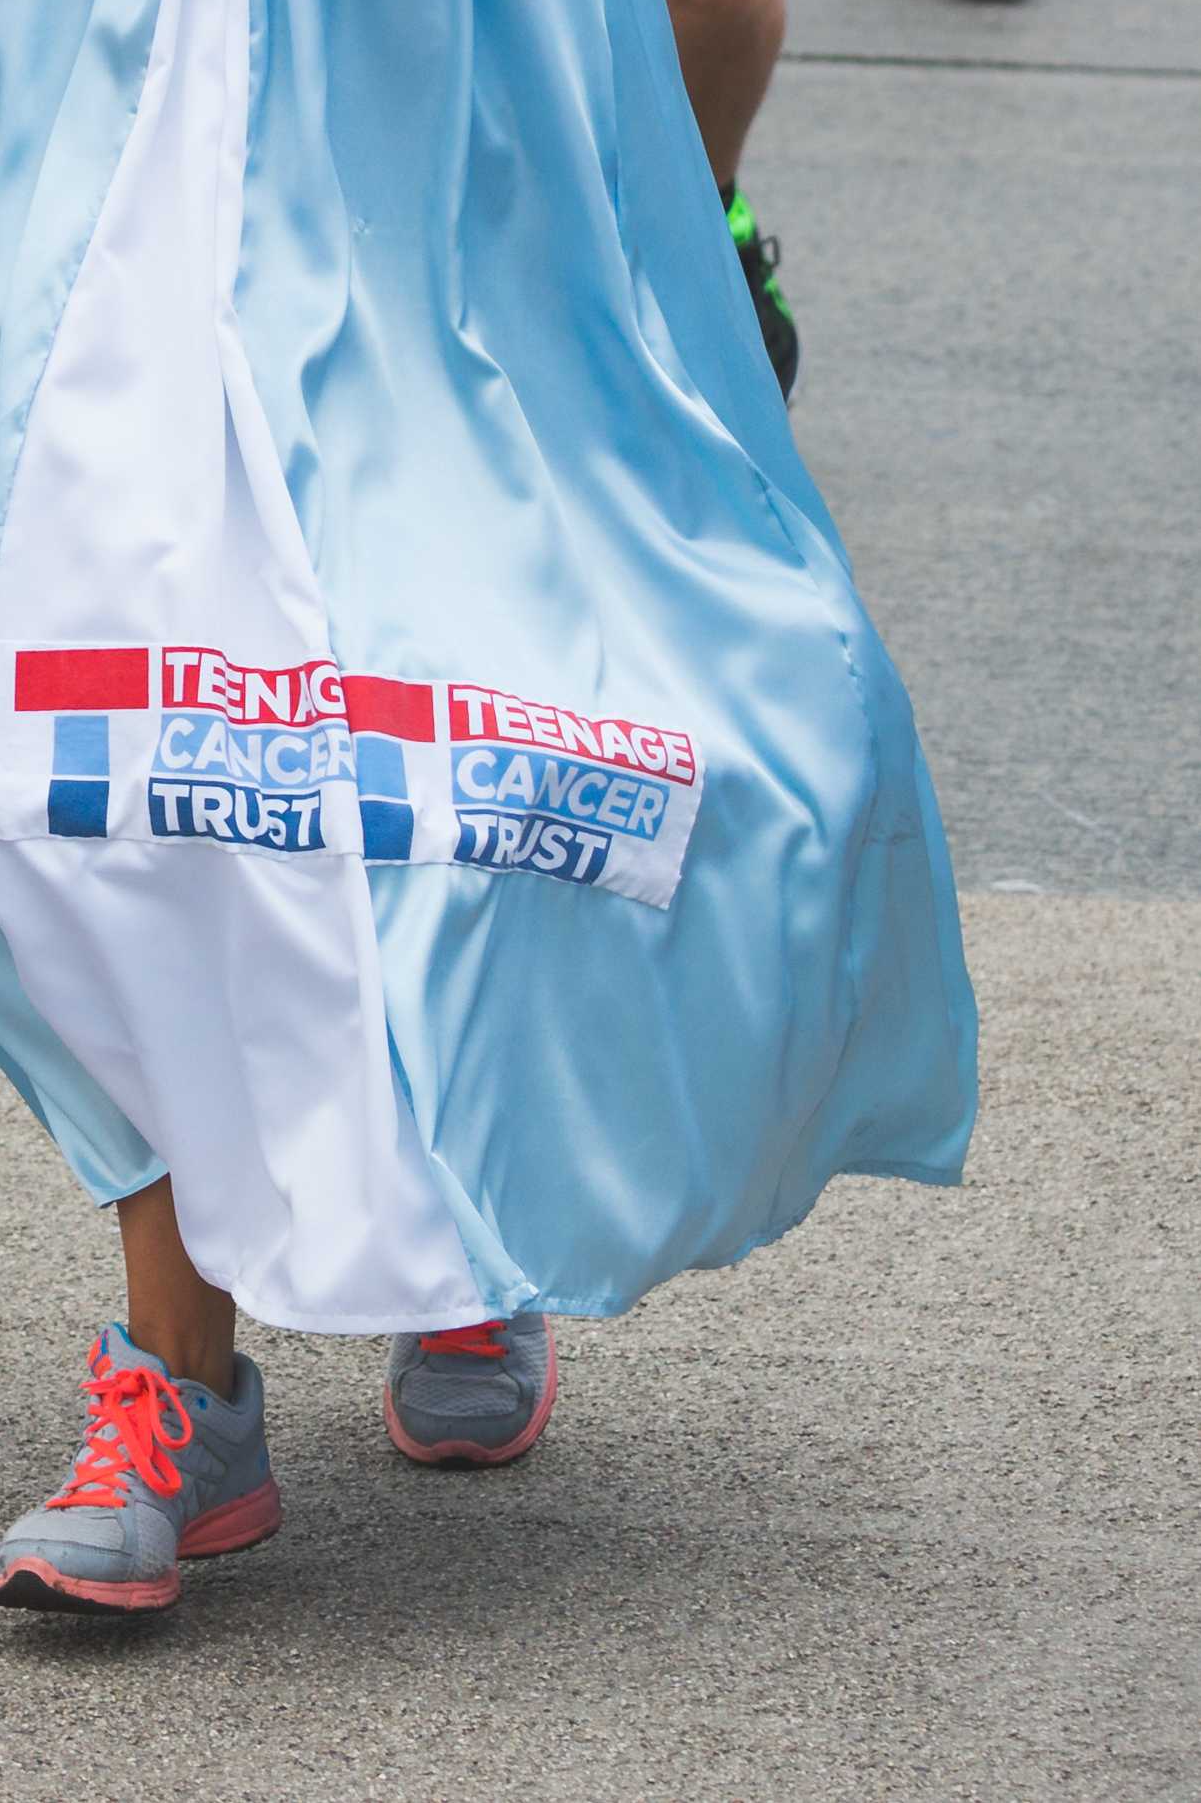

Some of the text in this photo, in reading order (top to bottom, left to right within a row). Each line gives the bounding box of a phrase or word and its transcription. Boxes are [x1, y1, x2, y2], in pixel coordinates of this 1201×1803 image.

[165, 652, 347, 723] TEENAG
[160, 717, 356, 787] CANCER
[453, 690, 694, 779] TEENAGE
[152, 784, 319, 846] TRUST
[457, 750, 665, 834] CANCER
[458, 814, 609, 881] TRUST
